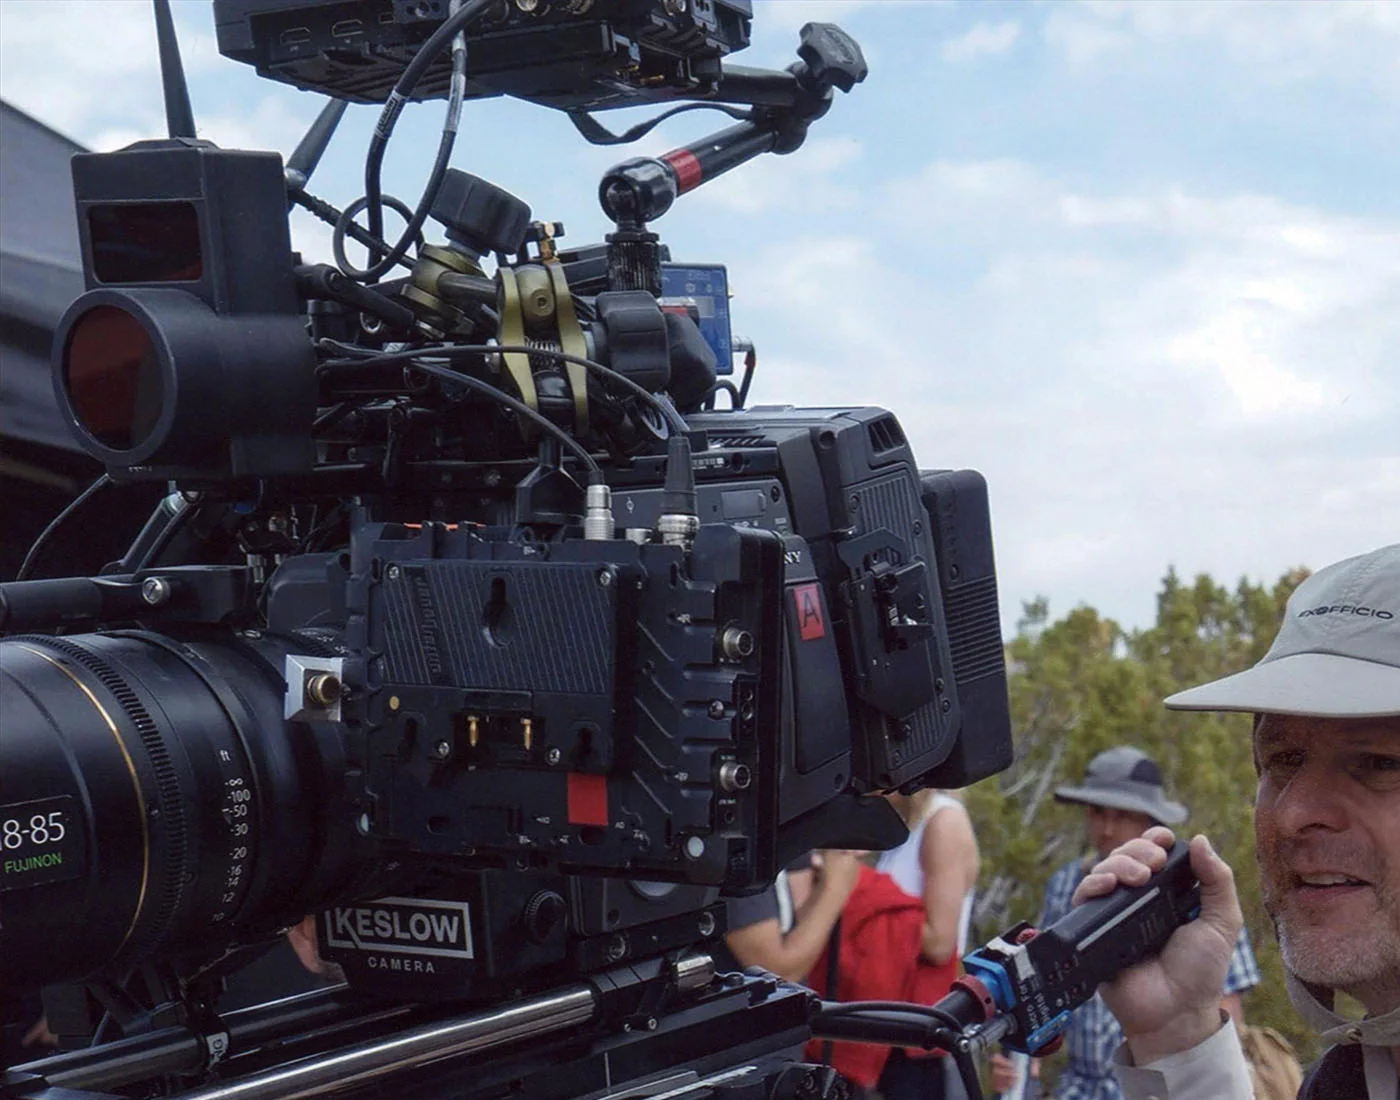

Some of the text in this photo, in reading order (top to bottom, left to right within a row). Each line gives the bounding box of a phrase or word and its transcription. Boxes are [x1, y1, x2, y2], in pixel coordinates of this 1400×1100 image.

[803, 592, 819, 628] A
[233, 804, 247, 817] 50
[0, 811, 65, 851] 8-85
[234, 823, 249, 836] 30
[233, 846, 247, 859] 20
[4, 852, 63, 873] FUJINON
[335, 907, 459, 948] KESLOW
[367, 956, 435, 974] CAMERA
